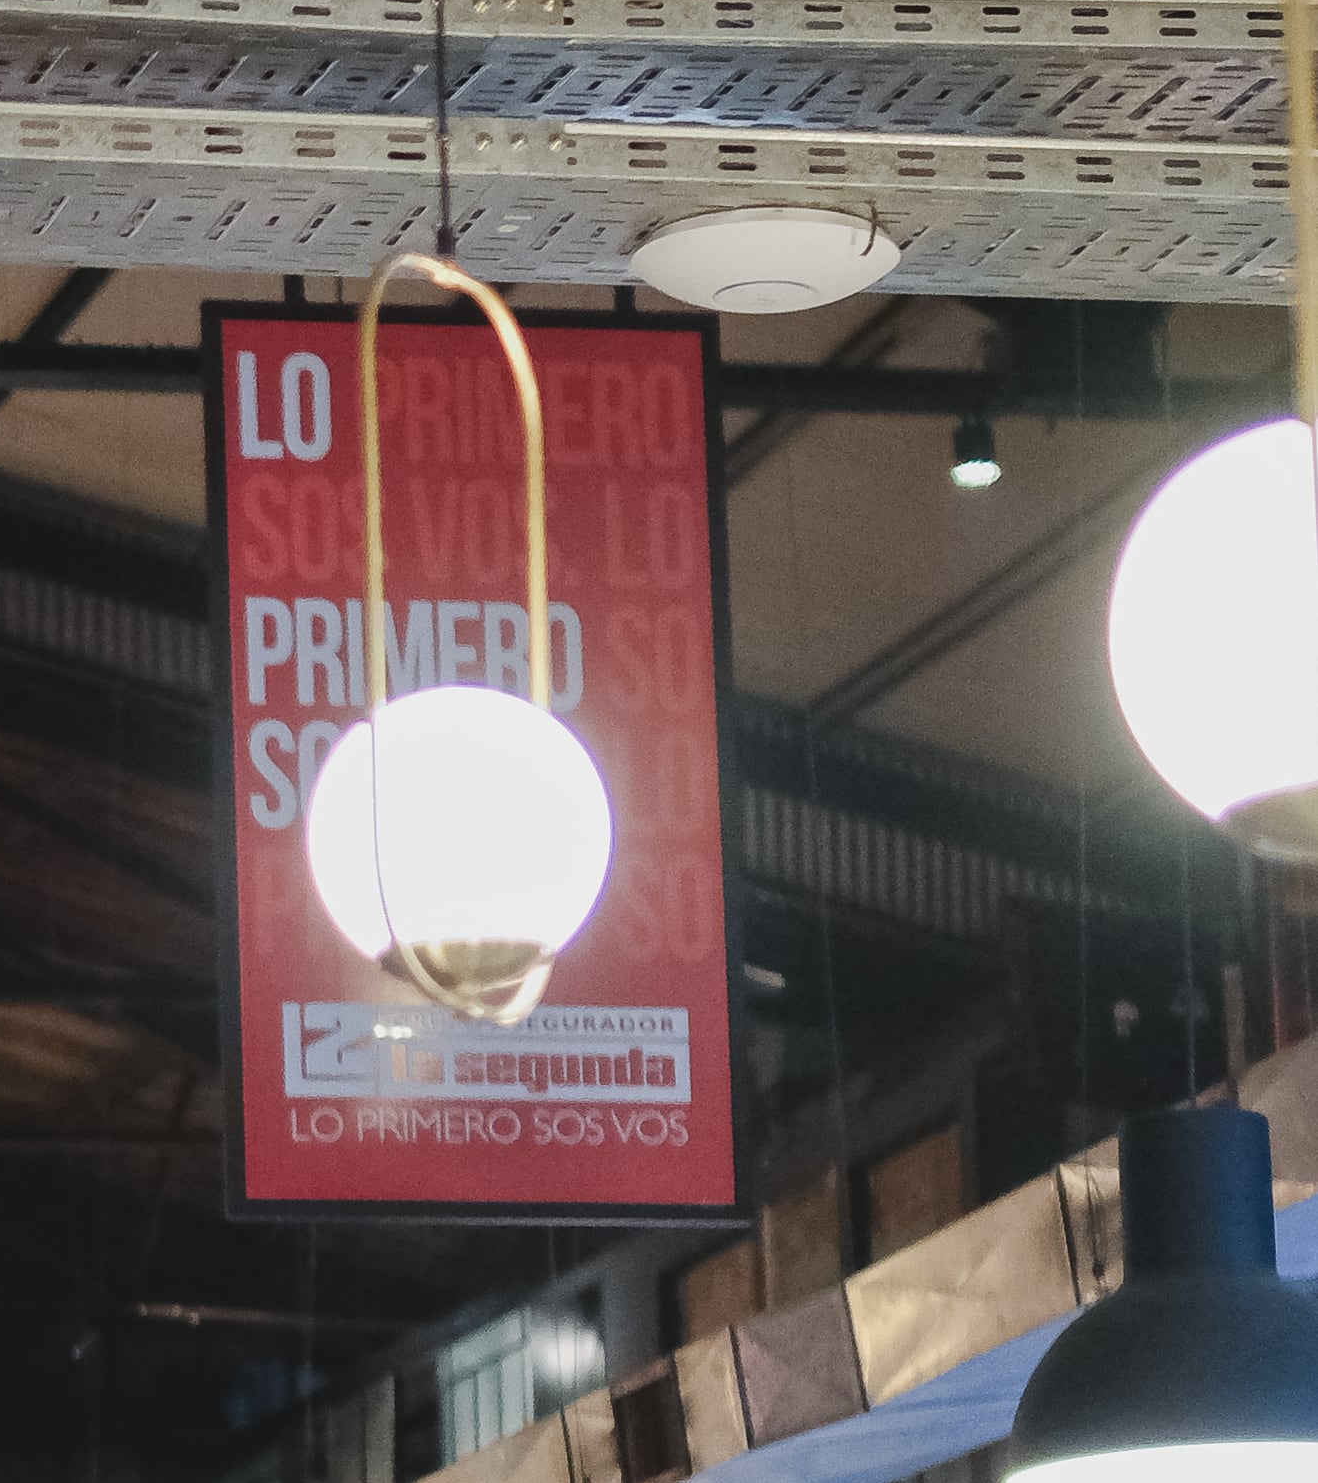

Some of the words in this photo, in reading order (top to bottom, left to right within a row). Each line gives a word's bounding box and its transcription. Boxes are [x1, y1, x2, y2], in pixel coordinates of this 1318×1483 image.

[237, 350, 332, 462] LO
[244, 596, 585, 714] PRIMERO
[454, 1045, 677, 1094] segunda
[291, 1106, 345, 1144] LO
[357, 1105, 522, 1145] PRIMERO
[533, 1108, 605, 1147] SOS
[612, 1108, 689, 1147] VOS
